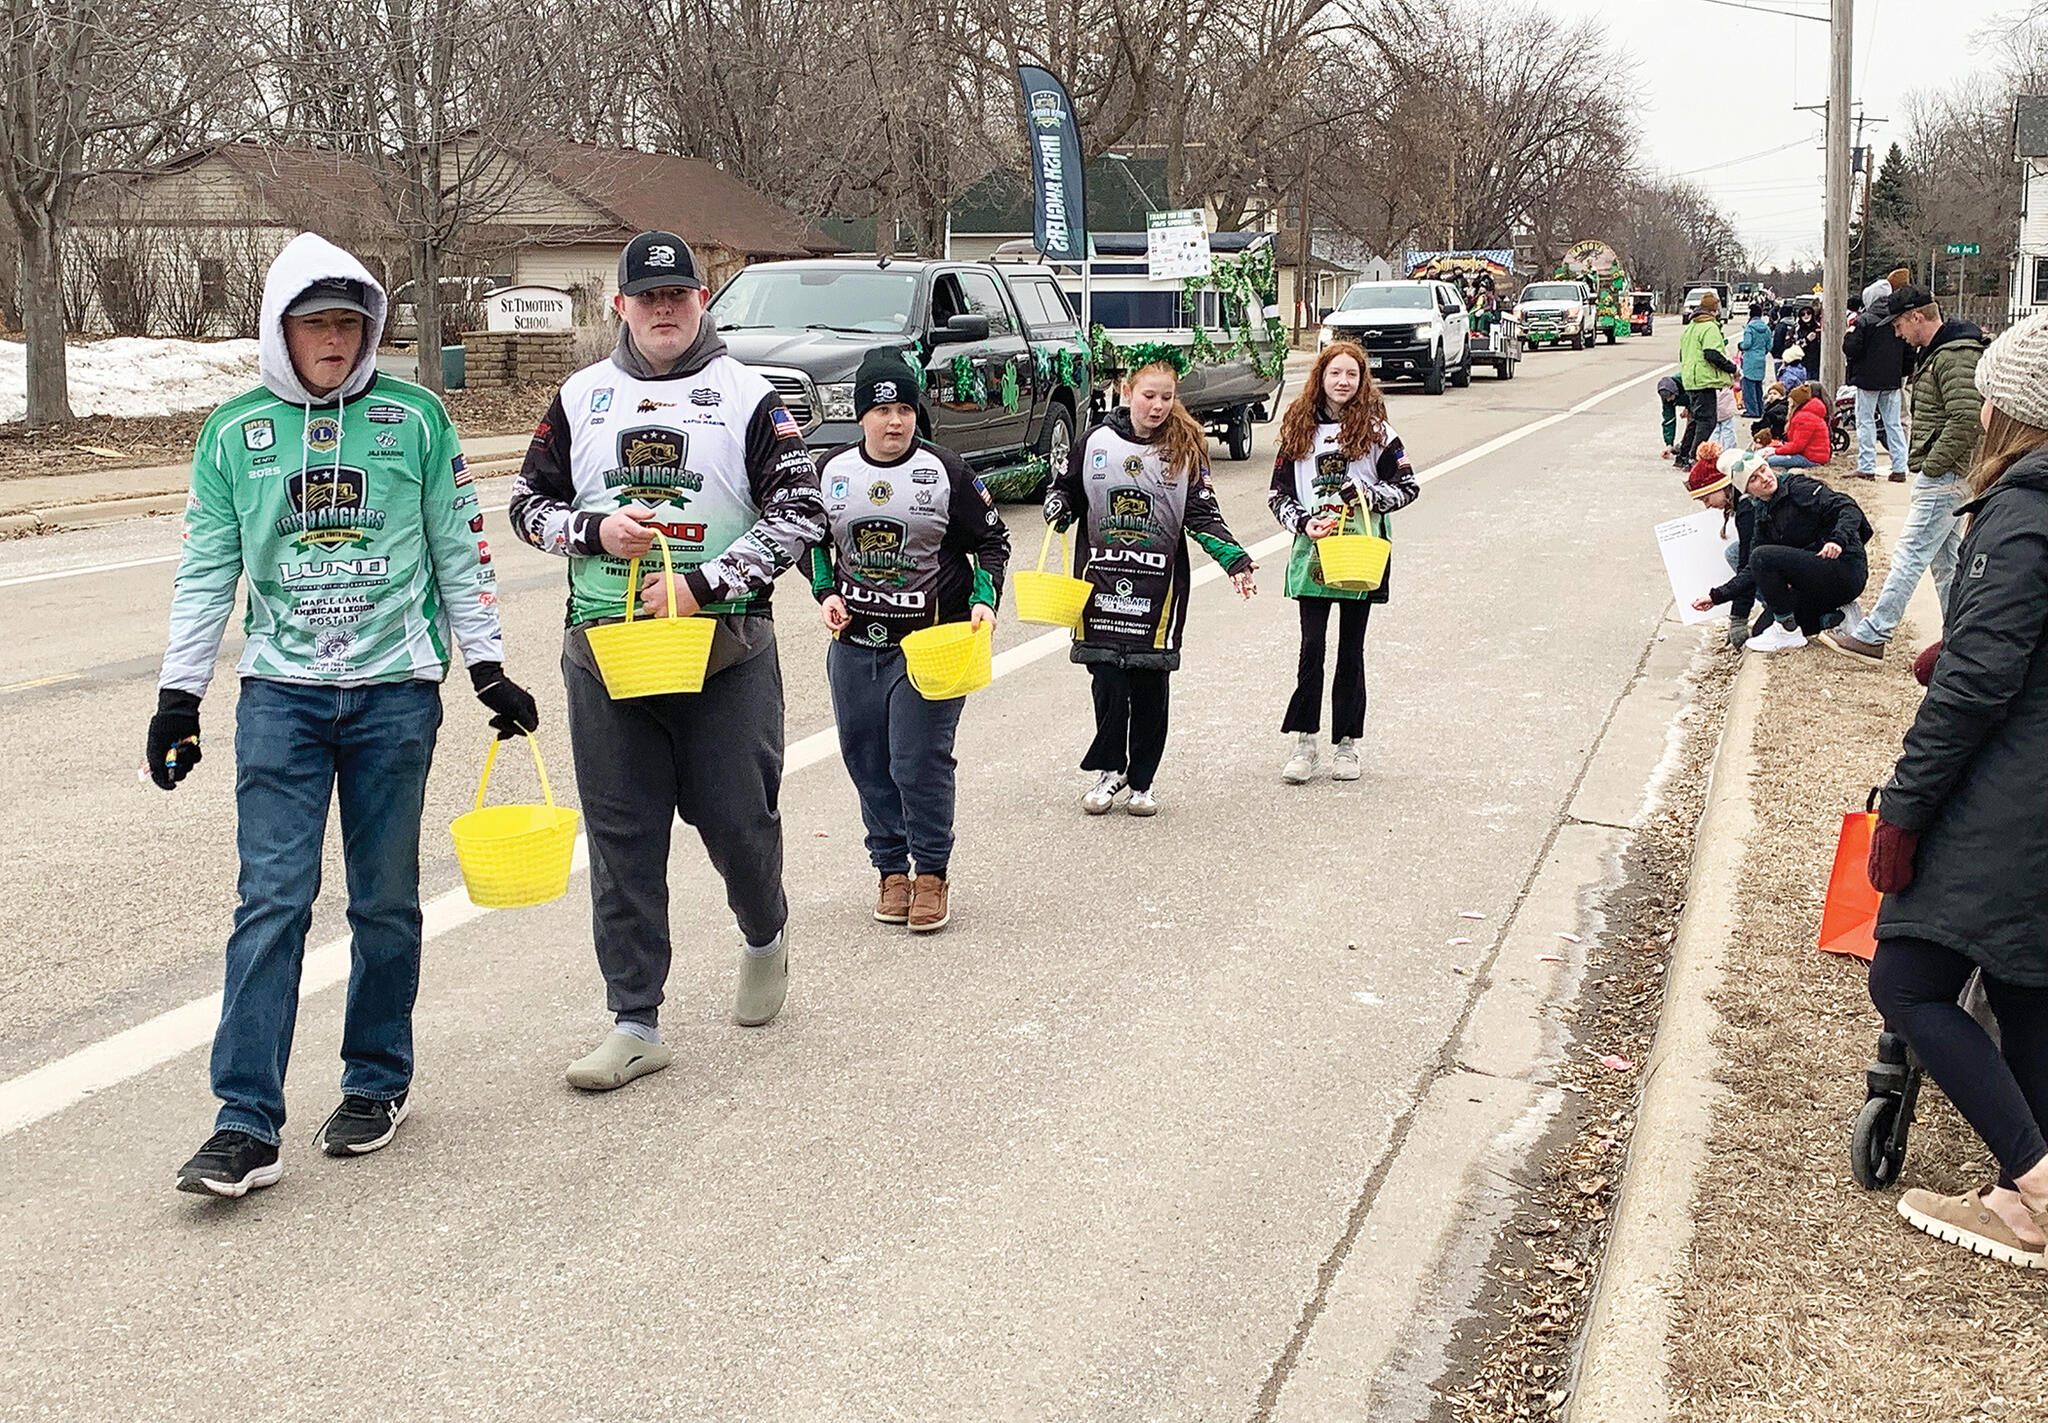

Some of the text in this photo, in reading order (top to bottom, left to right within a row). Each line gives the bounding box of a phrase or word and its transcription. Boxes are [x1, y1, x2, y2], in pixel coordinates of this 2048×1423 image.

[1947, 244, 1980, 254] Park Ave S
[514, 315, 552, 329] SCHOOL
[248, 466, 281, 479] 2025
[790, 465, 812, 475] POST
[603, 465, 704, 492] IRISH ANGLERS
[275, 506, 386, 537] IRISH ANGLERS
[639, 521, 705, 543] ND
[638, 558, 657, 567] AKE
[659, 561, 700, 570] POPERT
[1089, 547, 1166, 569] LUND
[279, 557, 389, 584] LUND
[338, 595, 366, 604] LAKE
[841, 581, 926, 609] LUND
[293, 603, 376, 616] AMERICAN LEGION
[309, 614, 359, 625] POST 131
